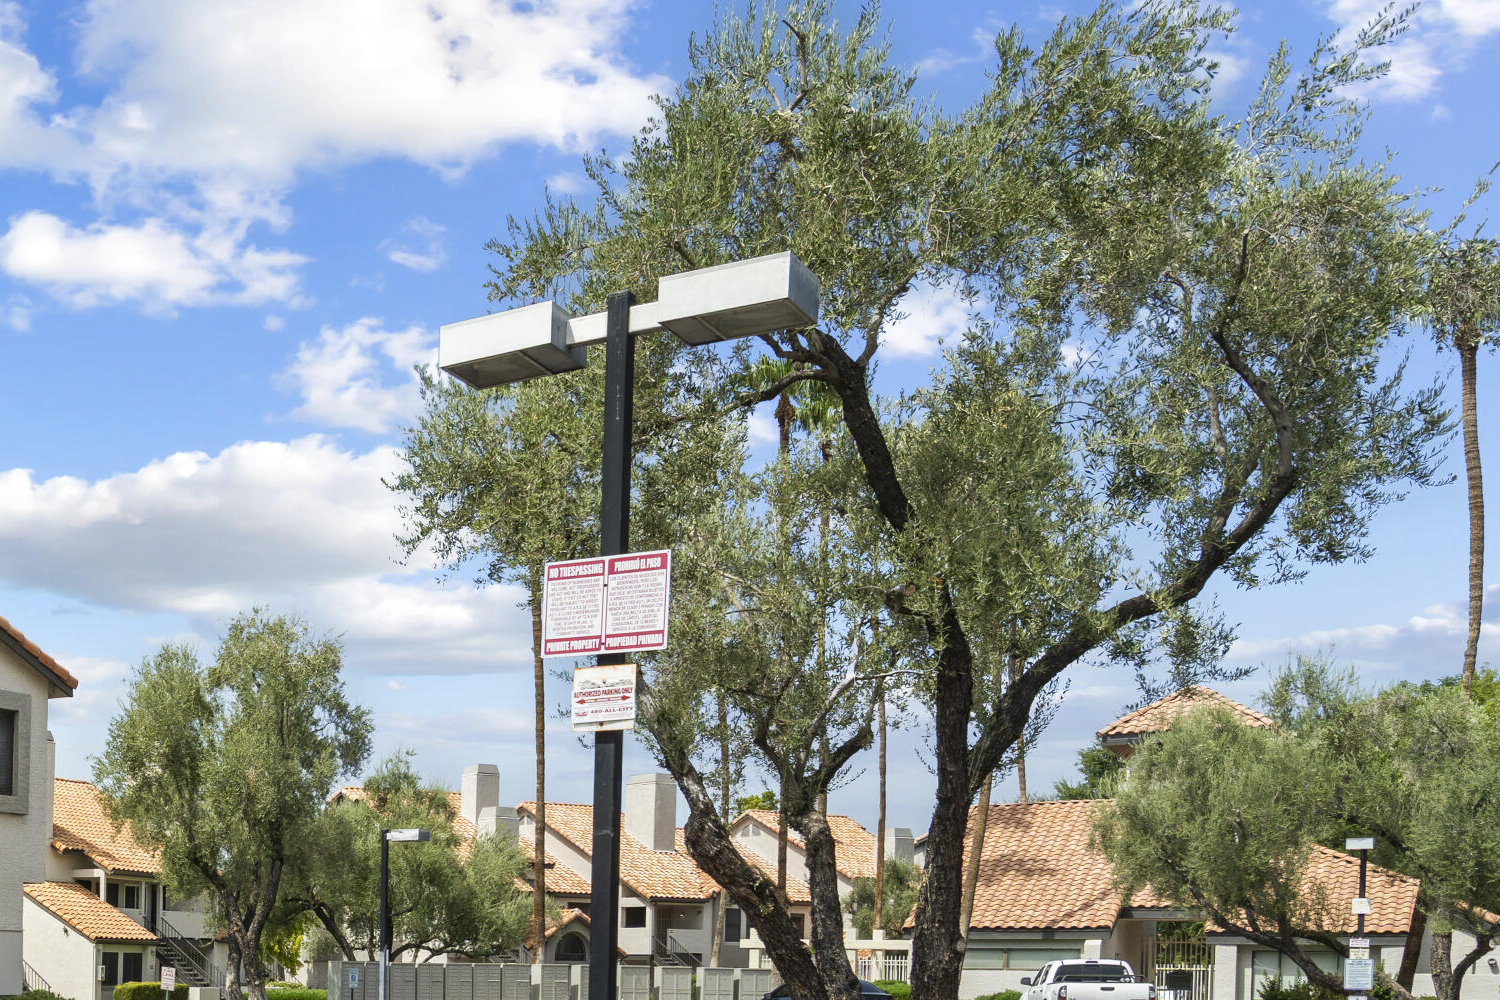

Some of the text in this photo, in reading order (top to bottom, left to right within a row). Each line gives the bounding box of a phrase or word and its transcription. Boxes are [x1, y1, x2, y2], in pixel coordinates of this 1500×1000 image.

[640, 559, 647, 569] EL
[647, 557, 662, 568] PASO
[549, 567, 559, 579] NO
[560, 563, 604, 577] TRESPASSING
[546, 638, 600, 652] PRIVATE PROPERTY
[606, 633, 663, 648] PROPIEDAD PRIVADA
[574, 690, 601, 698] AUTHORIZED
[602, 688, 621, 696] PARKING
